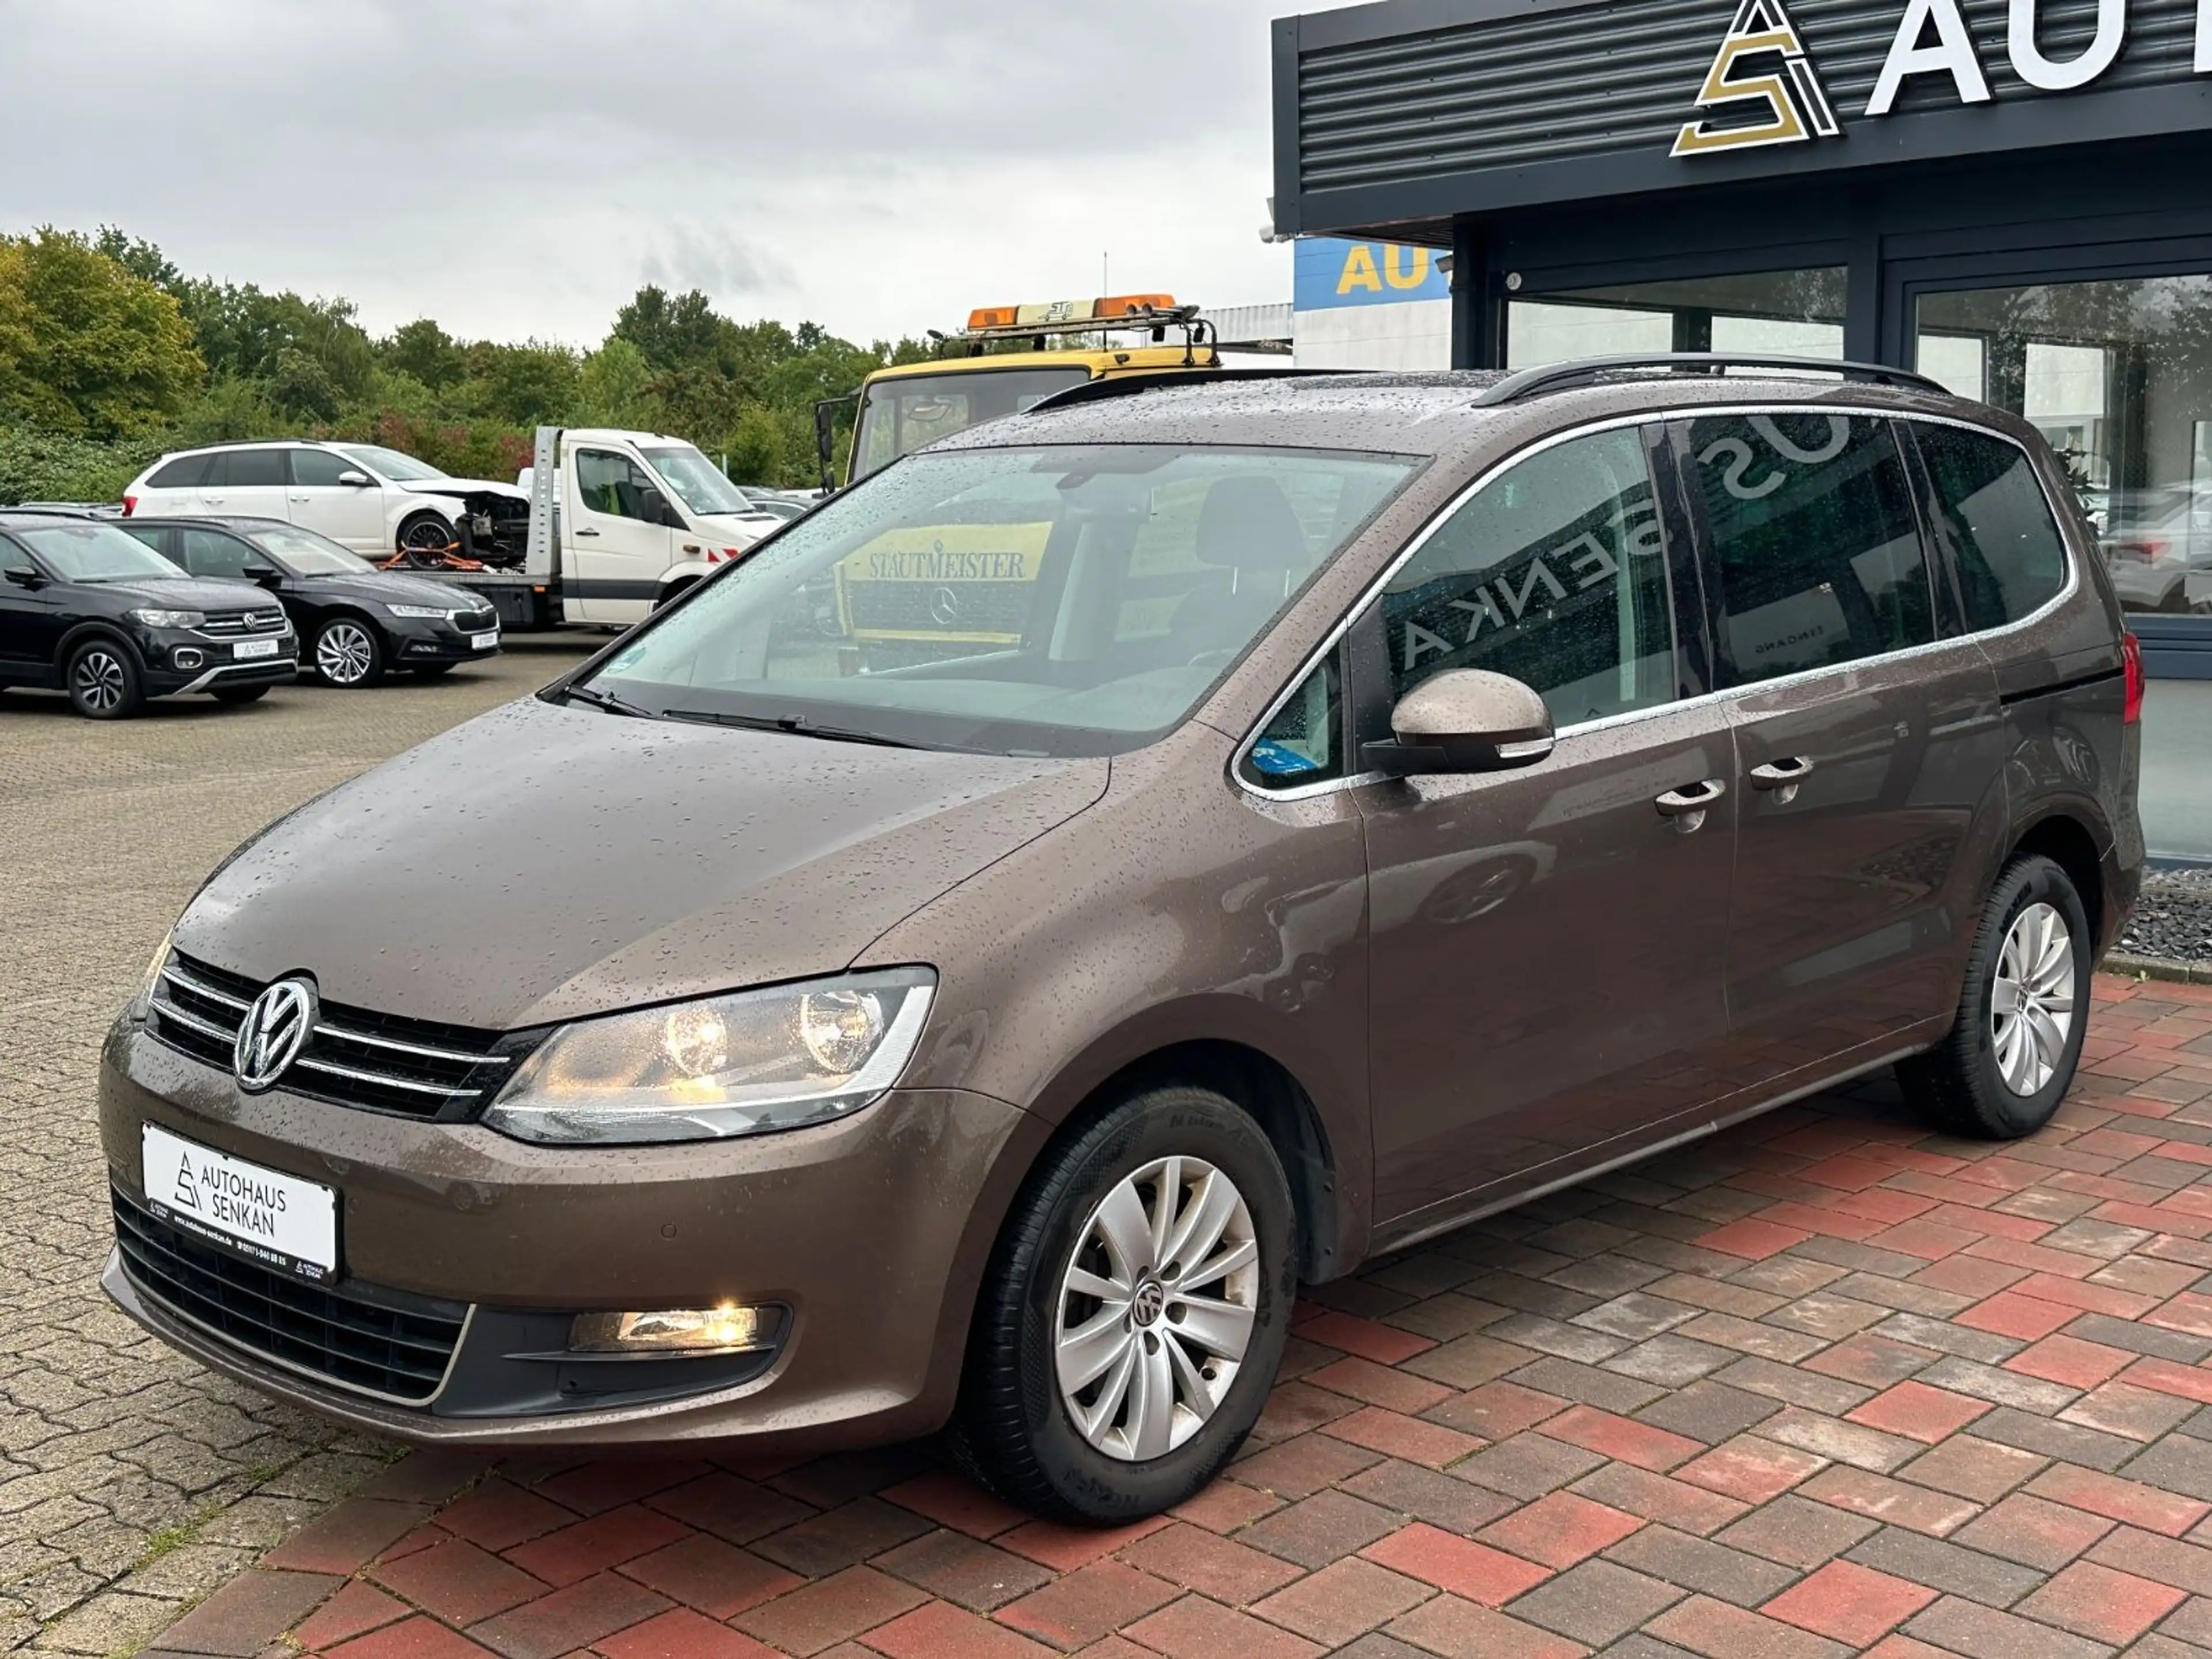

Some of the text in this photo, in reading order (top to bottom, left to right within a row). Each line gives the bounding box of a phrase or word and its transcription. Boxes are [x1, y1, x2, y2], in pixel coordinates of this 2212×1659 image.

[870, 552, 1024, 578] STAUTMEISTER
[200, 1165, 286, 1213] AUTOHAUS
[212, 1193, 275, 1238] SENKAN
